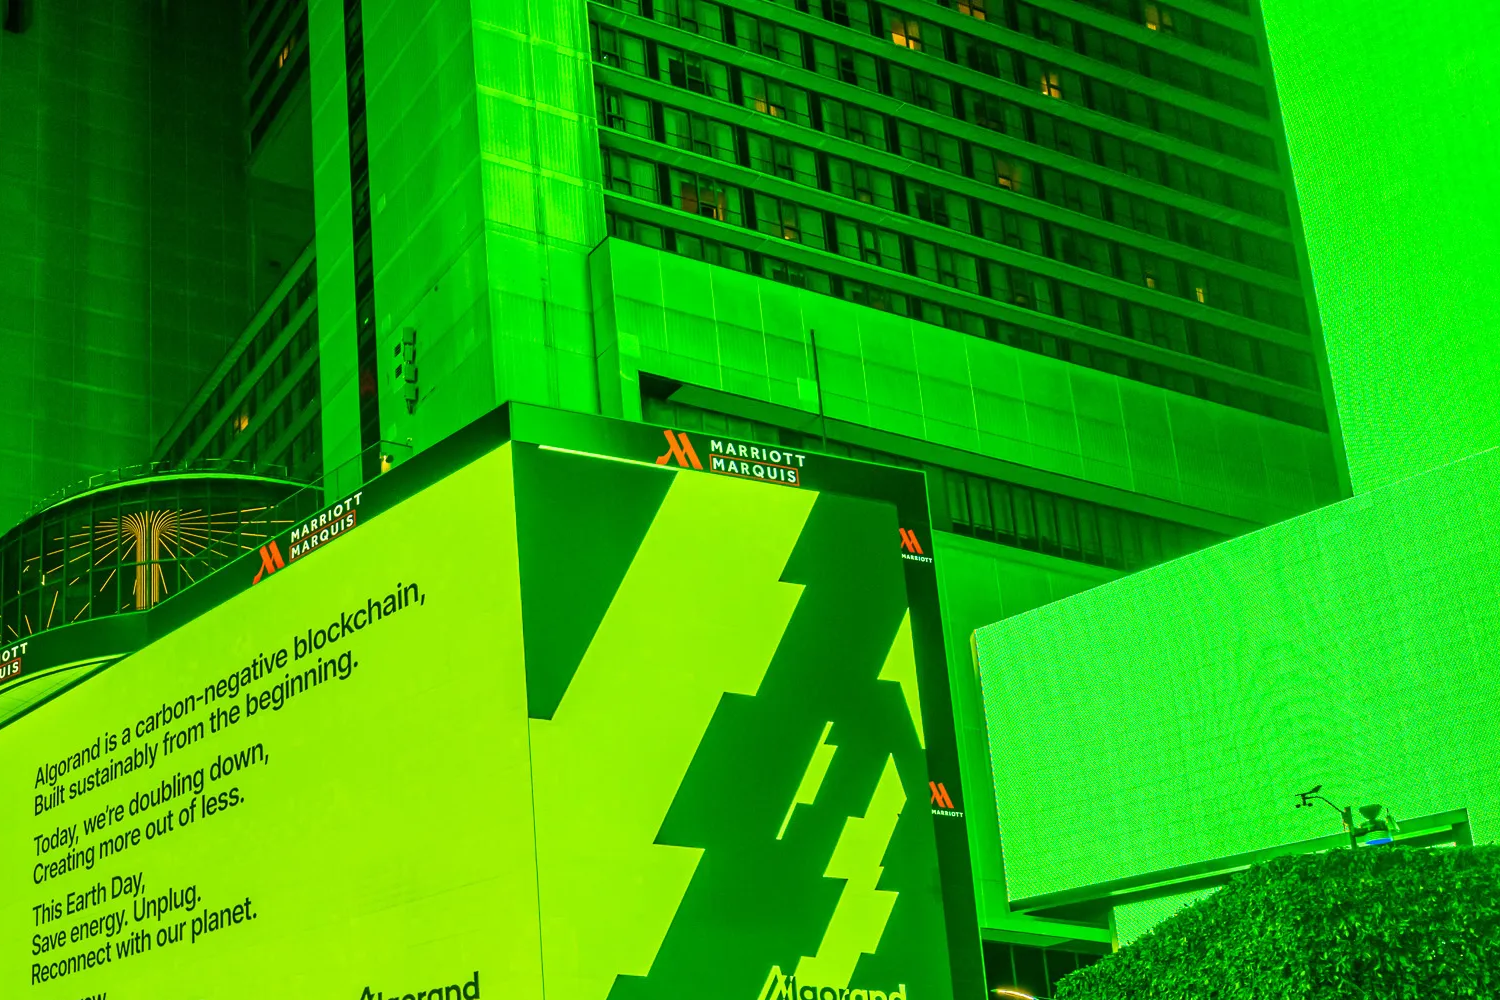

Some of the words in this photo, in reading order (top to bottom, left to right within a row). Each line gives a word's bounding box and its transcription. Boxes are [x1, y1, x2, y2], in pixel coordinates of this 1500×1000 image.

[710, 439, 806, 468] MARRIOTT
[712, 457, 797, 483] MARQUIS
[290, 491, 363, 544] MARRIOTT
[291, 514, 354, 559] MARQUIS
[901, 553, 933, 563] MARRIOTT
[35, 737, 101, 789] Algorand
[105, 732, 118, 755] is
[121, 727, 131, 746] a
[136, 648, 288, 738] carbon-negative
[294, 582, 426, 660] blockchain,
[34, 784, 67, 816] Built
[69, 742, 159, 800] sustainably
[163, 721, 205, 757] from
[209, 704, 241, 733] the
[246, 650, 359, 718] beginning.
[33, 823, 79, 857] Today,
[129, 767, 205, 816] doubling
[210, 742, 269, 781] down,
[931, 808, 964, 818] MARRIOTT
[33, 845, 95, 885] Creating
[100, 827, 141, 859] more
[145, 809, 174, 841] out
[178, 796, 197, 826] of
[202, 787, 245, 818] less.
[31, 930, 67, 956] Save
[70, 909, 129, 944] energy.
[133, 884, 202, 922] Unplug.
[32, 902, 63, 927] This
[67, 882, 107, 915] Earth
[111, 871, 146, 900] Day,
[31, 941, 112, 985] Reconnect
[115, 928, 152, 959] with
[156, 920, 187, 948] our
[191, 897, 257, 943] planet.
